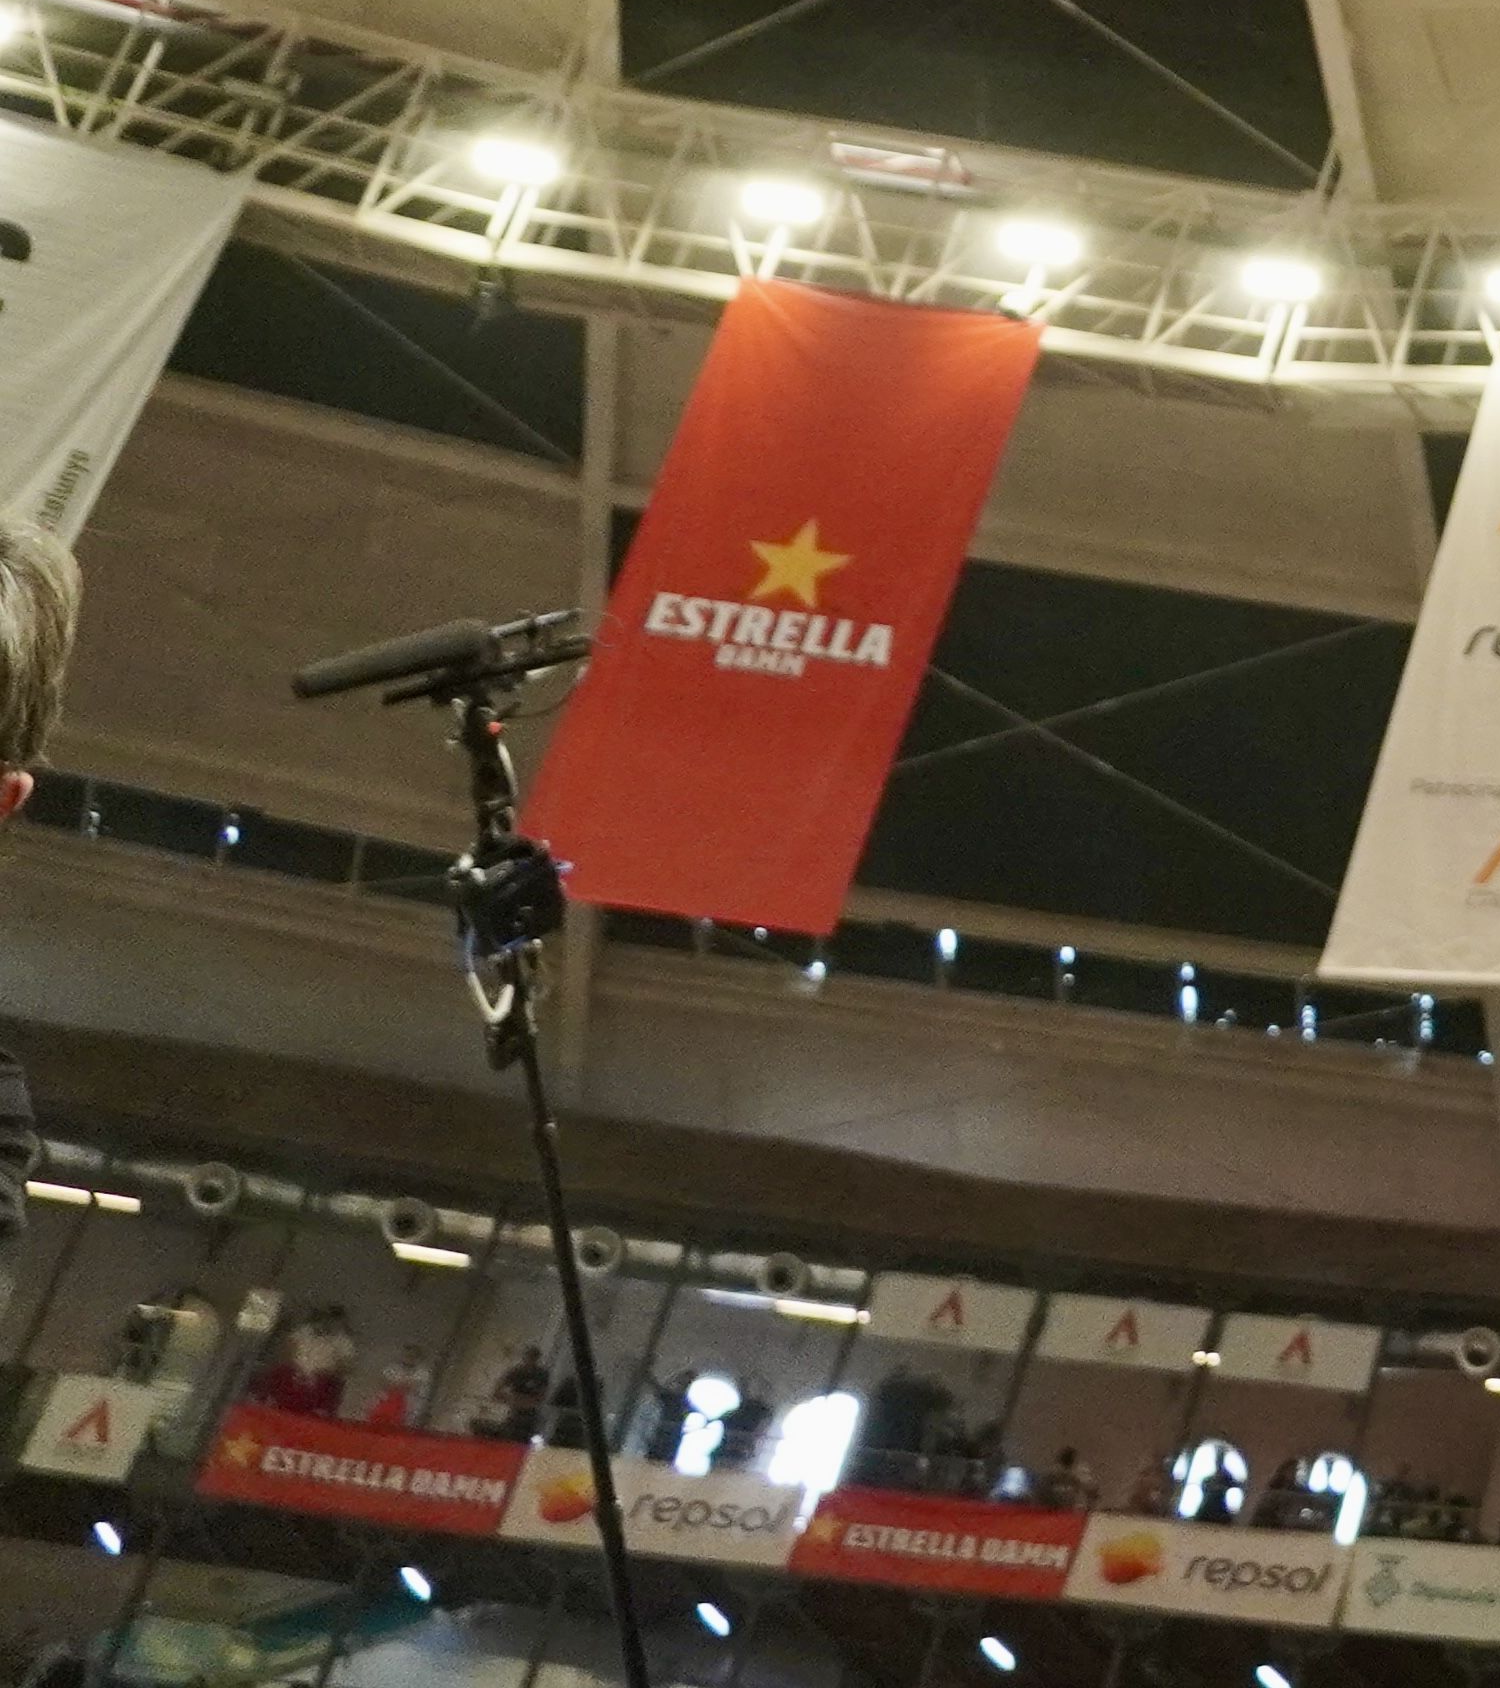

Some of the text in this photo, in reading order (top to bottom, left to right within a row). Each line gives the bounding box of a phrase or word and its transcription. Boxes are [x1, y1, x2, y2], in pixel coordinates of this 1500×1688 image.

[644, 590, 896, 667] ESTRELLA
[713, 643, 806, 680] DAMM
[261, 1446, 407, 1492] ESTRELLA
[629, 1493, 792, 1531] repsol
[841, 1522, 977, 1561] ESTRELLA
[1180, 1555, 1332, 1593] repsol
